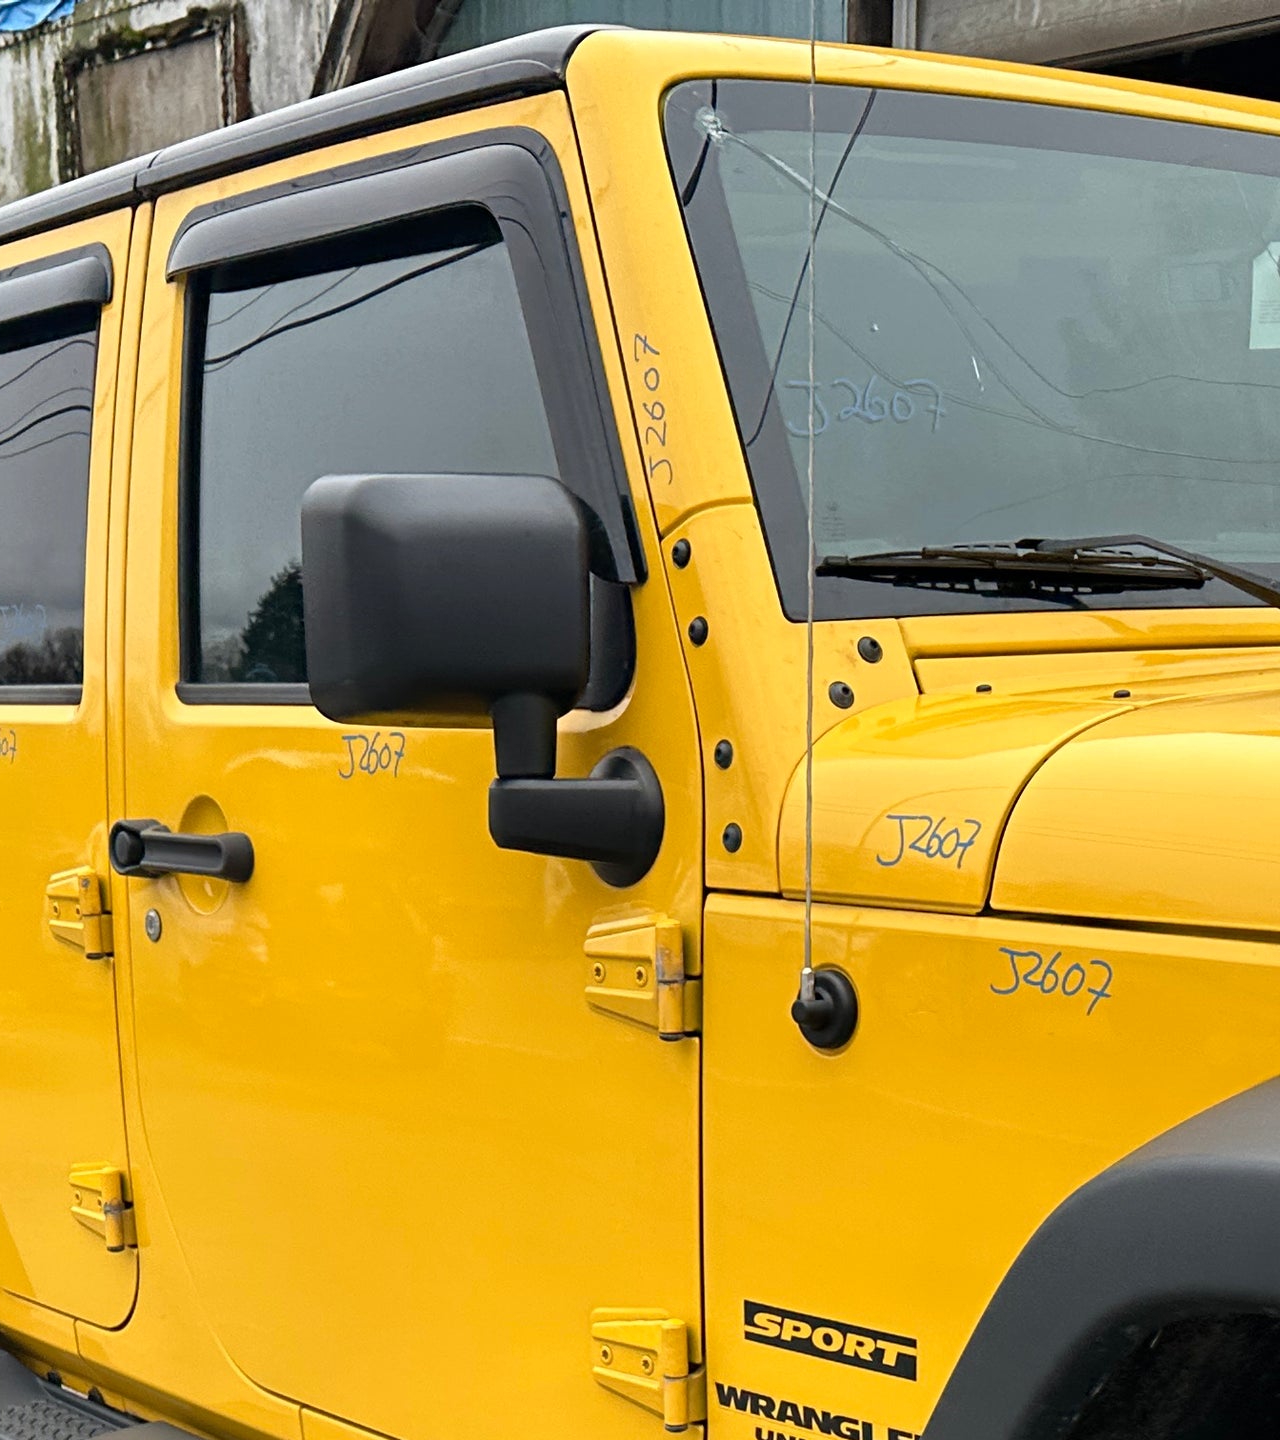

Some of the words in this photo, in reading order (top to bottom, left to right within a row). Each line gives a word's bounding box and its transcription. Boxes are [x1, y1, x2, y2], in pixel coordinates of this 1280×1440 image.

[634, 333, 673, 485] J2607
[784, 375, 947, 437] J2607
[338, 732, 406, 779] J2607
[876, 814, 981, 869] J2607
[990, 947, 1113, 1016] J2607
[745, 1311, 917, 1368] SPORT
